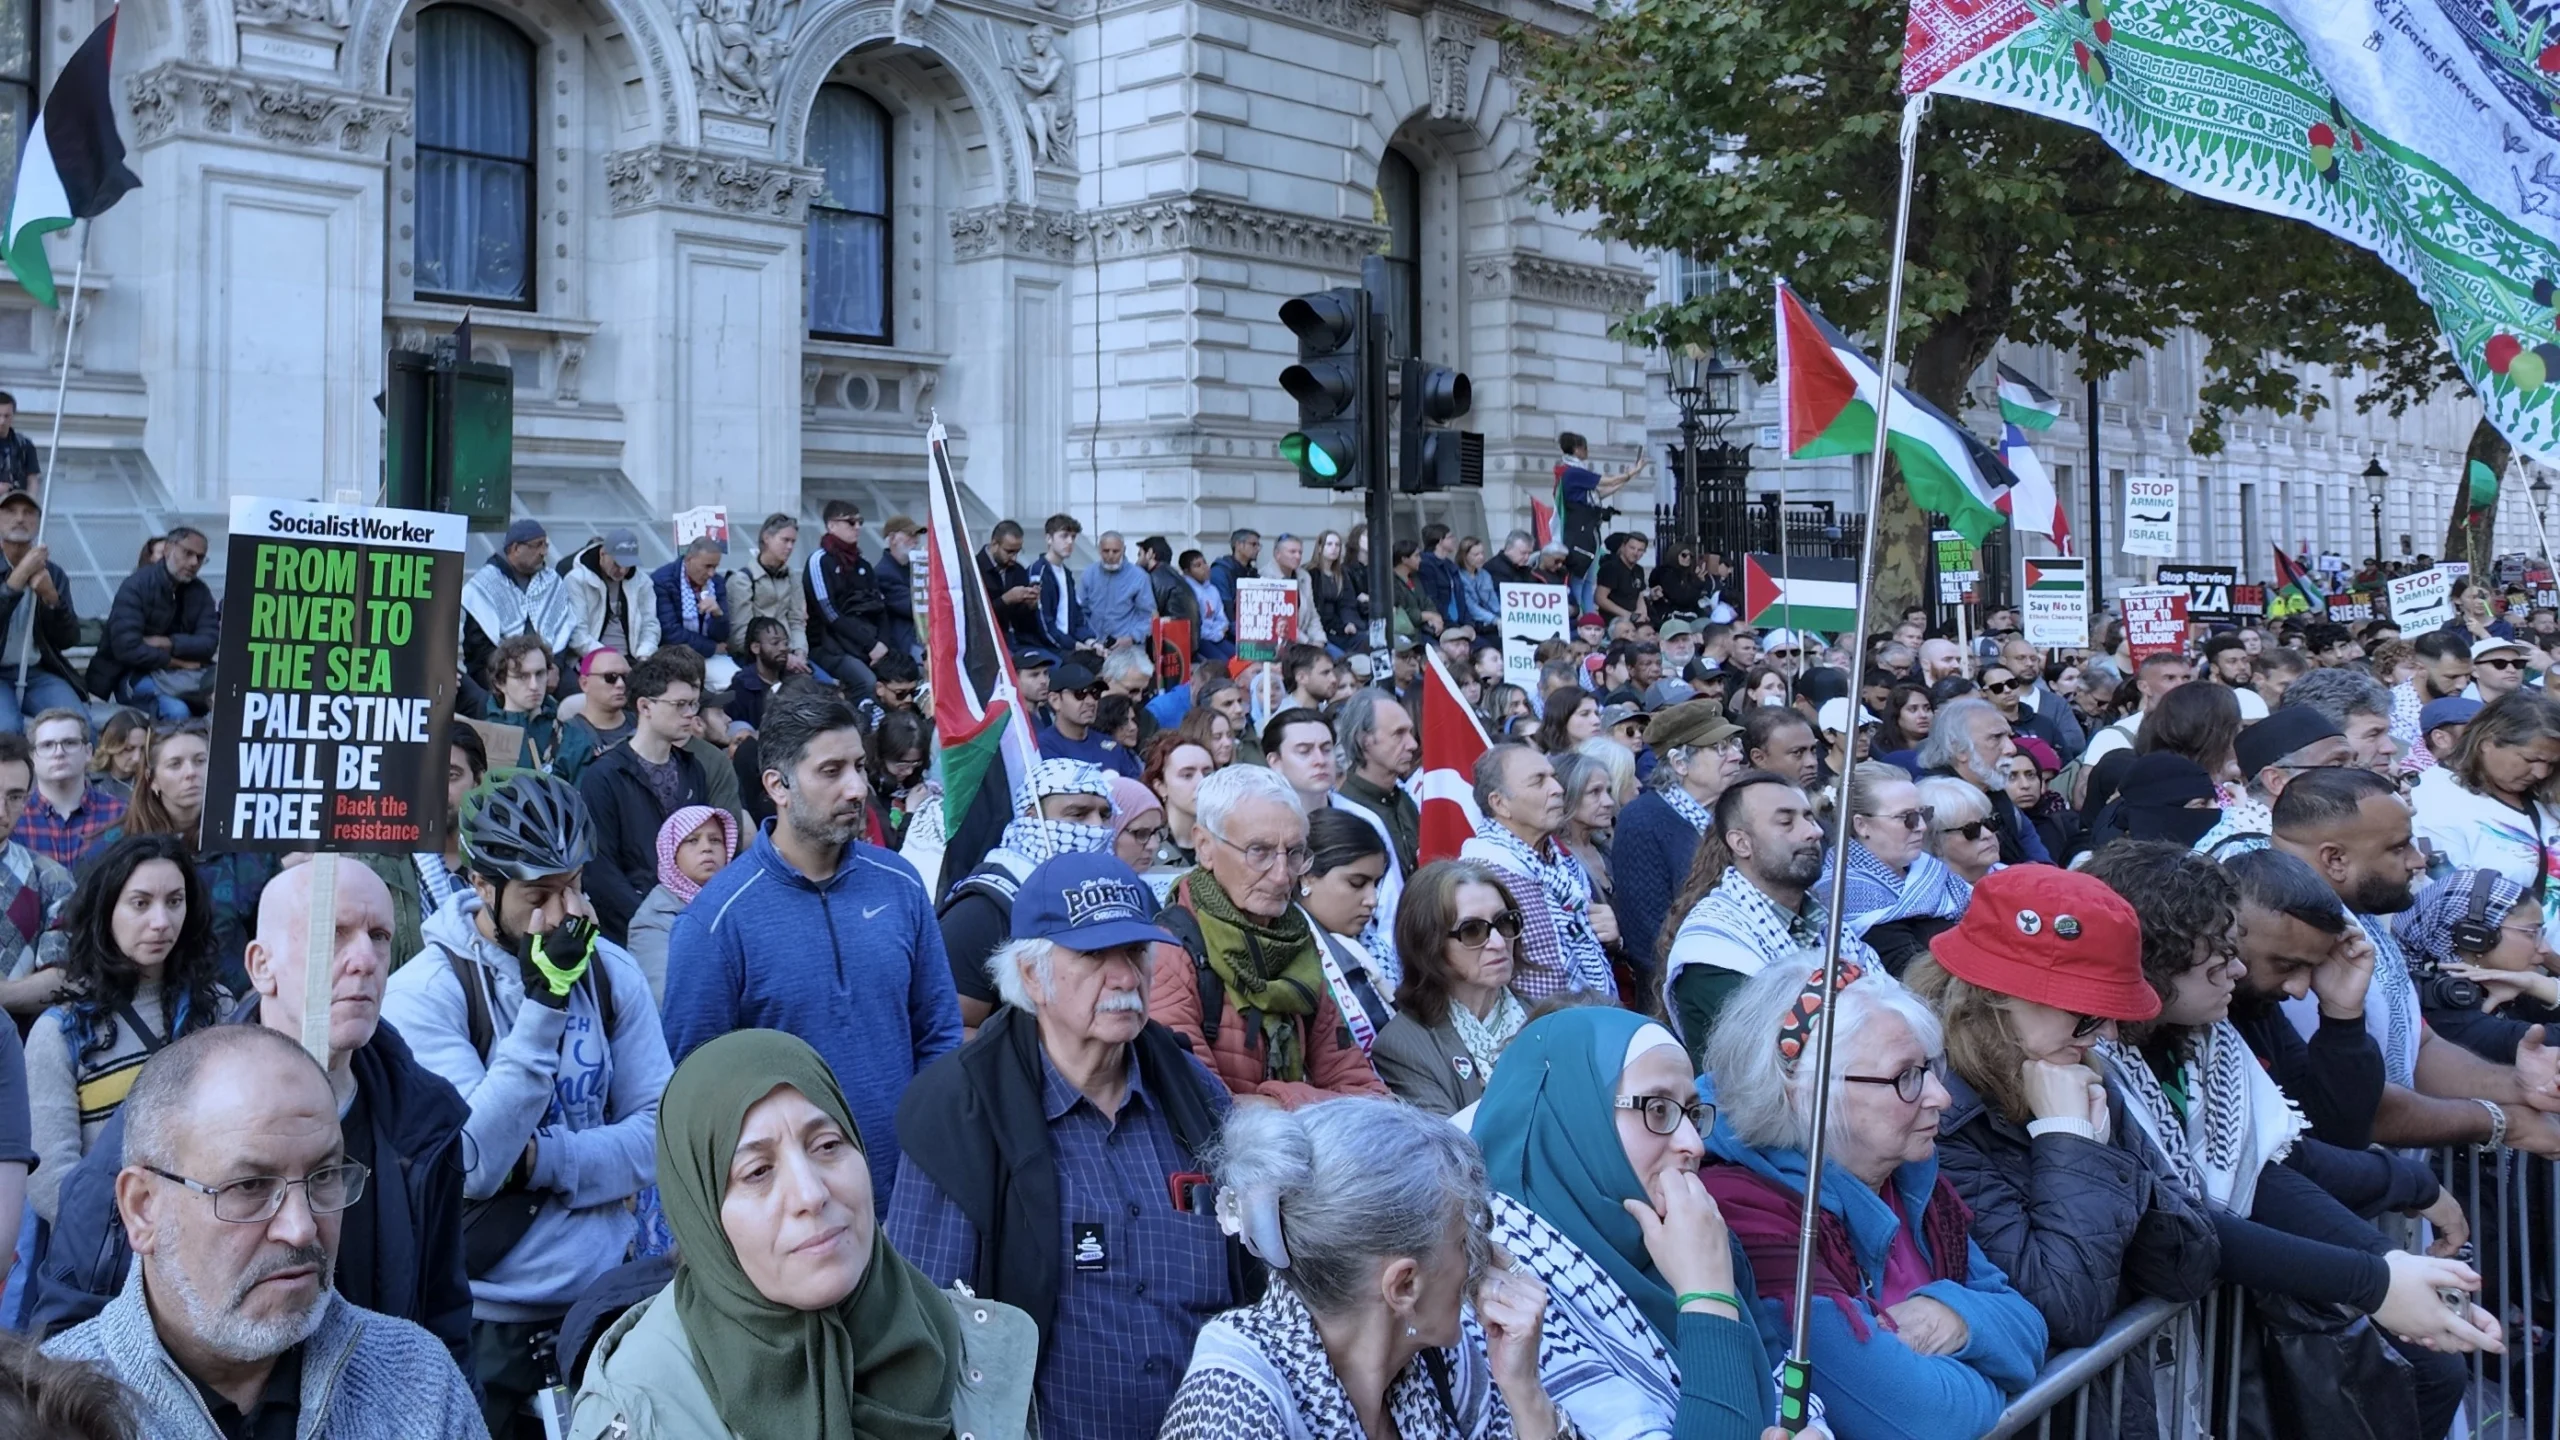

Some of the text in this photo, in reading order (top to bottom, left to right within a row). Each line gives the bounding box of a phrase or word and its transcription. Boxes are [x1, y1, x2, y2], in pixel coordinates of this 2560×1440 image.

[2388, 9, 2440, 63] hearts
[2432, 53, 2493, 113] forever
[2131, 482, 2174, 496] STOP
[2130, 497, 2174, 508] ARMING
[2129, 529, 2172, 541] ISRAEL
[254, 543, 435, 599] FROM THE
[2160, 571, 2232, 586] Stop Starving
[2446, 565, 2468, 573] TOP
[2395, 572, 2442, 595] STOP
[1507, 590, 1561, 609] STOP
[2144, 597, 2164, 610] NOT
[2396, 585, 2445, 605] ARMING
[2029, 601, 2082, 613] Say No to
[2158, 608, 2172, 620] TO
[2329, 604, 2374, 622] SIEGE
[250, 593, 413, 646] RIVER TO
[1507, 611, 1563, 626] ARMING
[2129, 620, 2184, 633] ACT AGAINST
[2402, 614, 2444, 633] SRAEL
[248, 642, 392, 693] THE SEA
[241, 692, 431, 743] PALESTINE
[238, 742, 383, 791] WILL BE
[335, 795, 408, 817] Back the
[231, 793, 324, 840] FREE
[334, 820, 420, 841] resistance
[1062, 884, 1144, 920] PORTO
[1093, 908, 1133, 921] ORIGINAL
